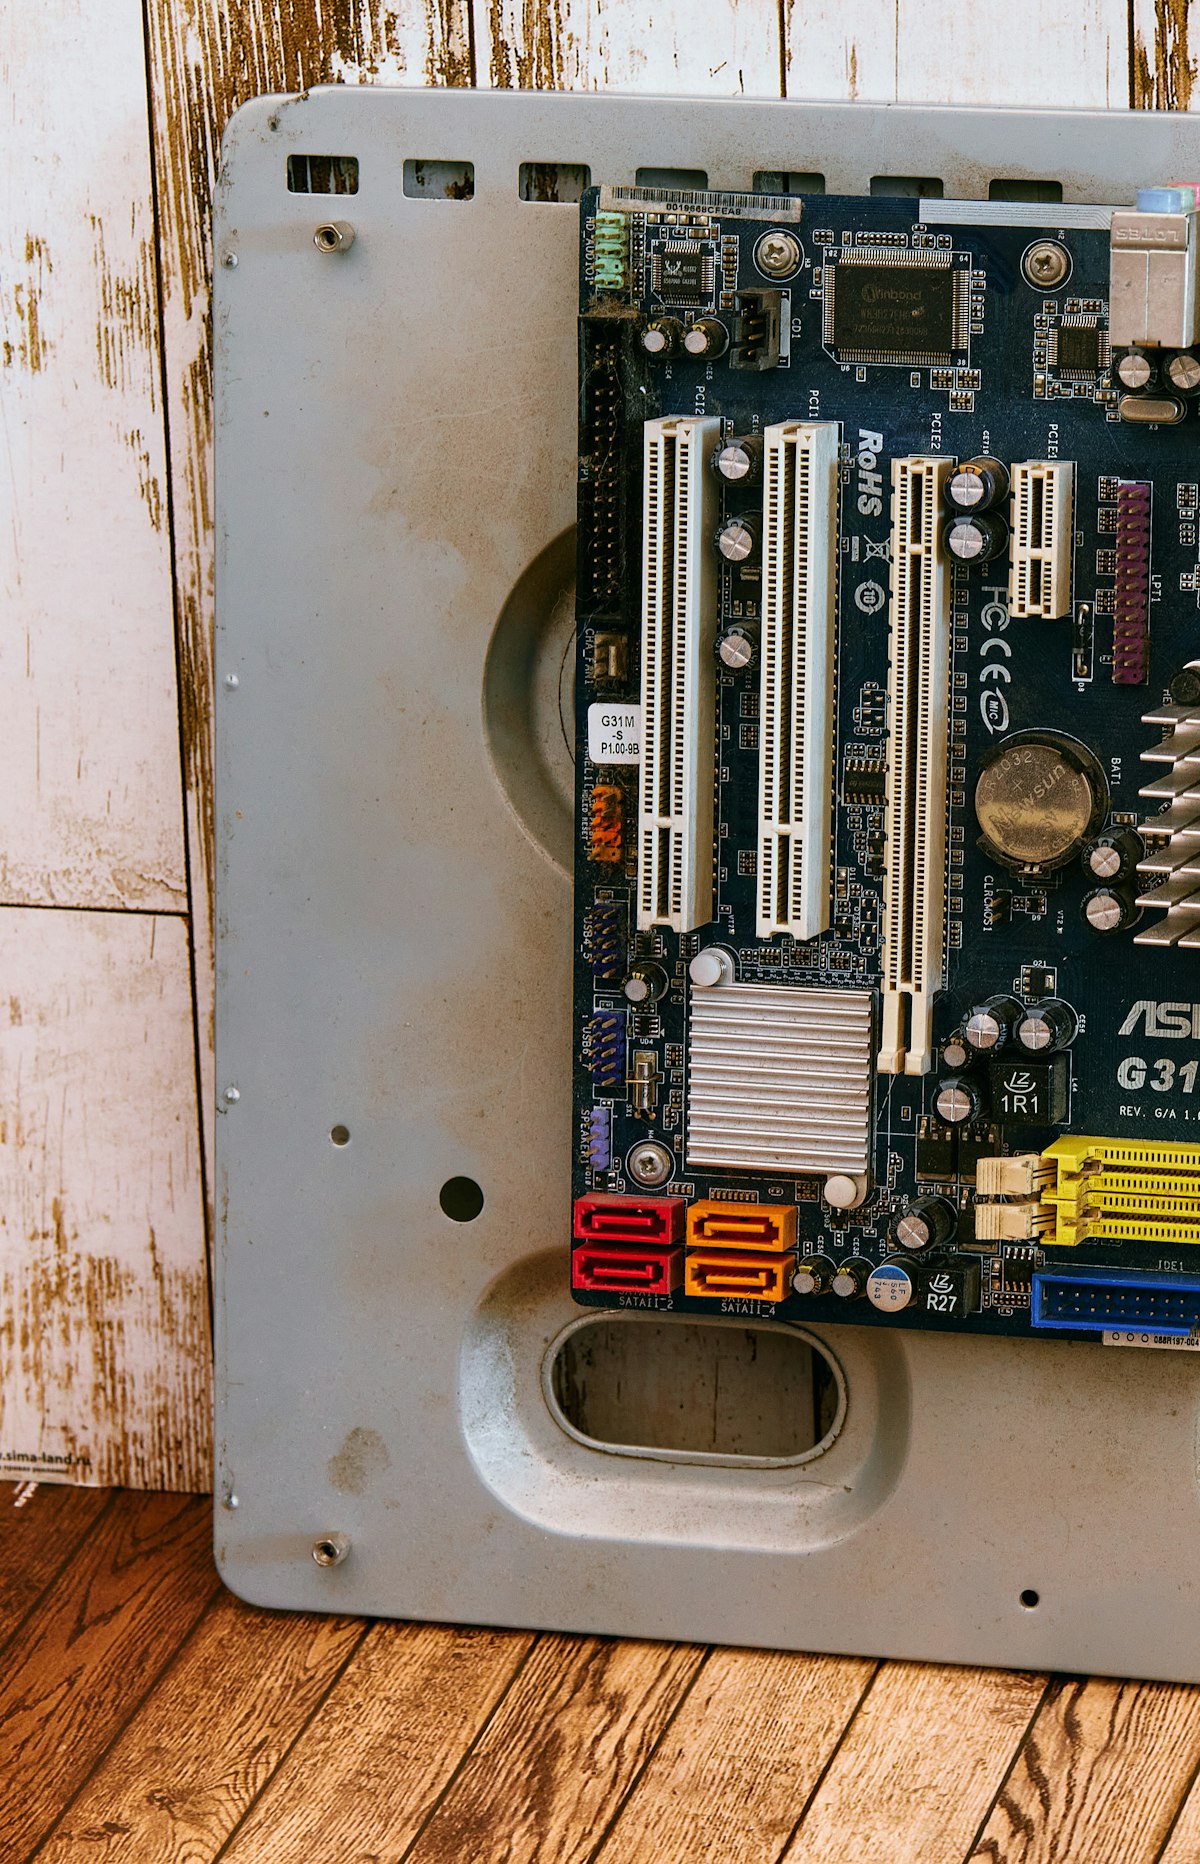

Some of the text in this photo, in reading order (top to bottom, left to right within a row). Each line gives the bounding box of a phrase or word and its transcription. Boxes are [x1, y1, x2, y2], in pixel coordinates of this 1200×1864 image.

[792, 317, 801, 338] CD1
[695, 385, 706, 415] PCI2
[809, 390, 819, 417] PCI1
[930, 412, 941, 450] PCIE2
[1048, 423, 1058, 459] PCIE1
[857, 428, 883, 517] RoHS
[1152, 574, 1161, 602] LPT1
[583, 628, 594, 685] CHA_FAN1
[601, 715, 635, 727] G31M
[612, 731, 623, 740] -S
[1111, 757, 1121, 786] BAT1
[983, 874, 993, 932] CLRCMOS1
[582, 916, 592, 960] USB4_5
[581, 1026, 592, 1070] USB6_7
[1001, 1095, 1039, 1114] 1R1
[1119, 1106, 1146, 1118] REV.
[1155, 1108, 1176, 1119] G/A
[580, 1109, 590, 1164] SPEAKER1
[619, 1297, 674, 1311] SATAII_2
[874, 1281, 882, 1300] 743
[927, 1296, 957, 1313] R27
[721, 1303, 776, 1318] SATAII_4
